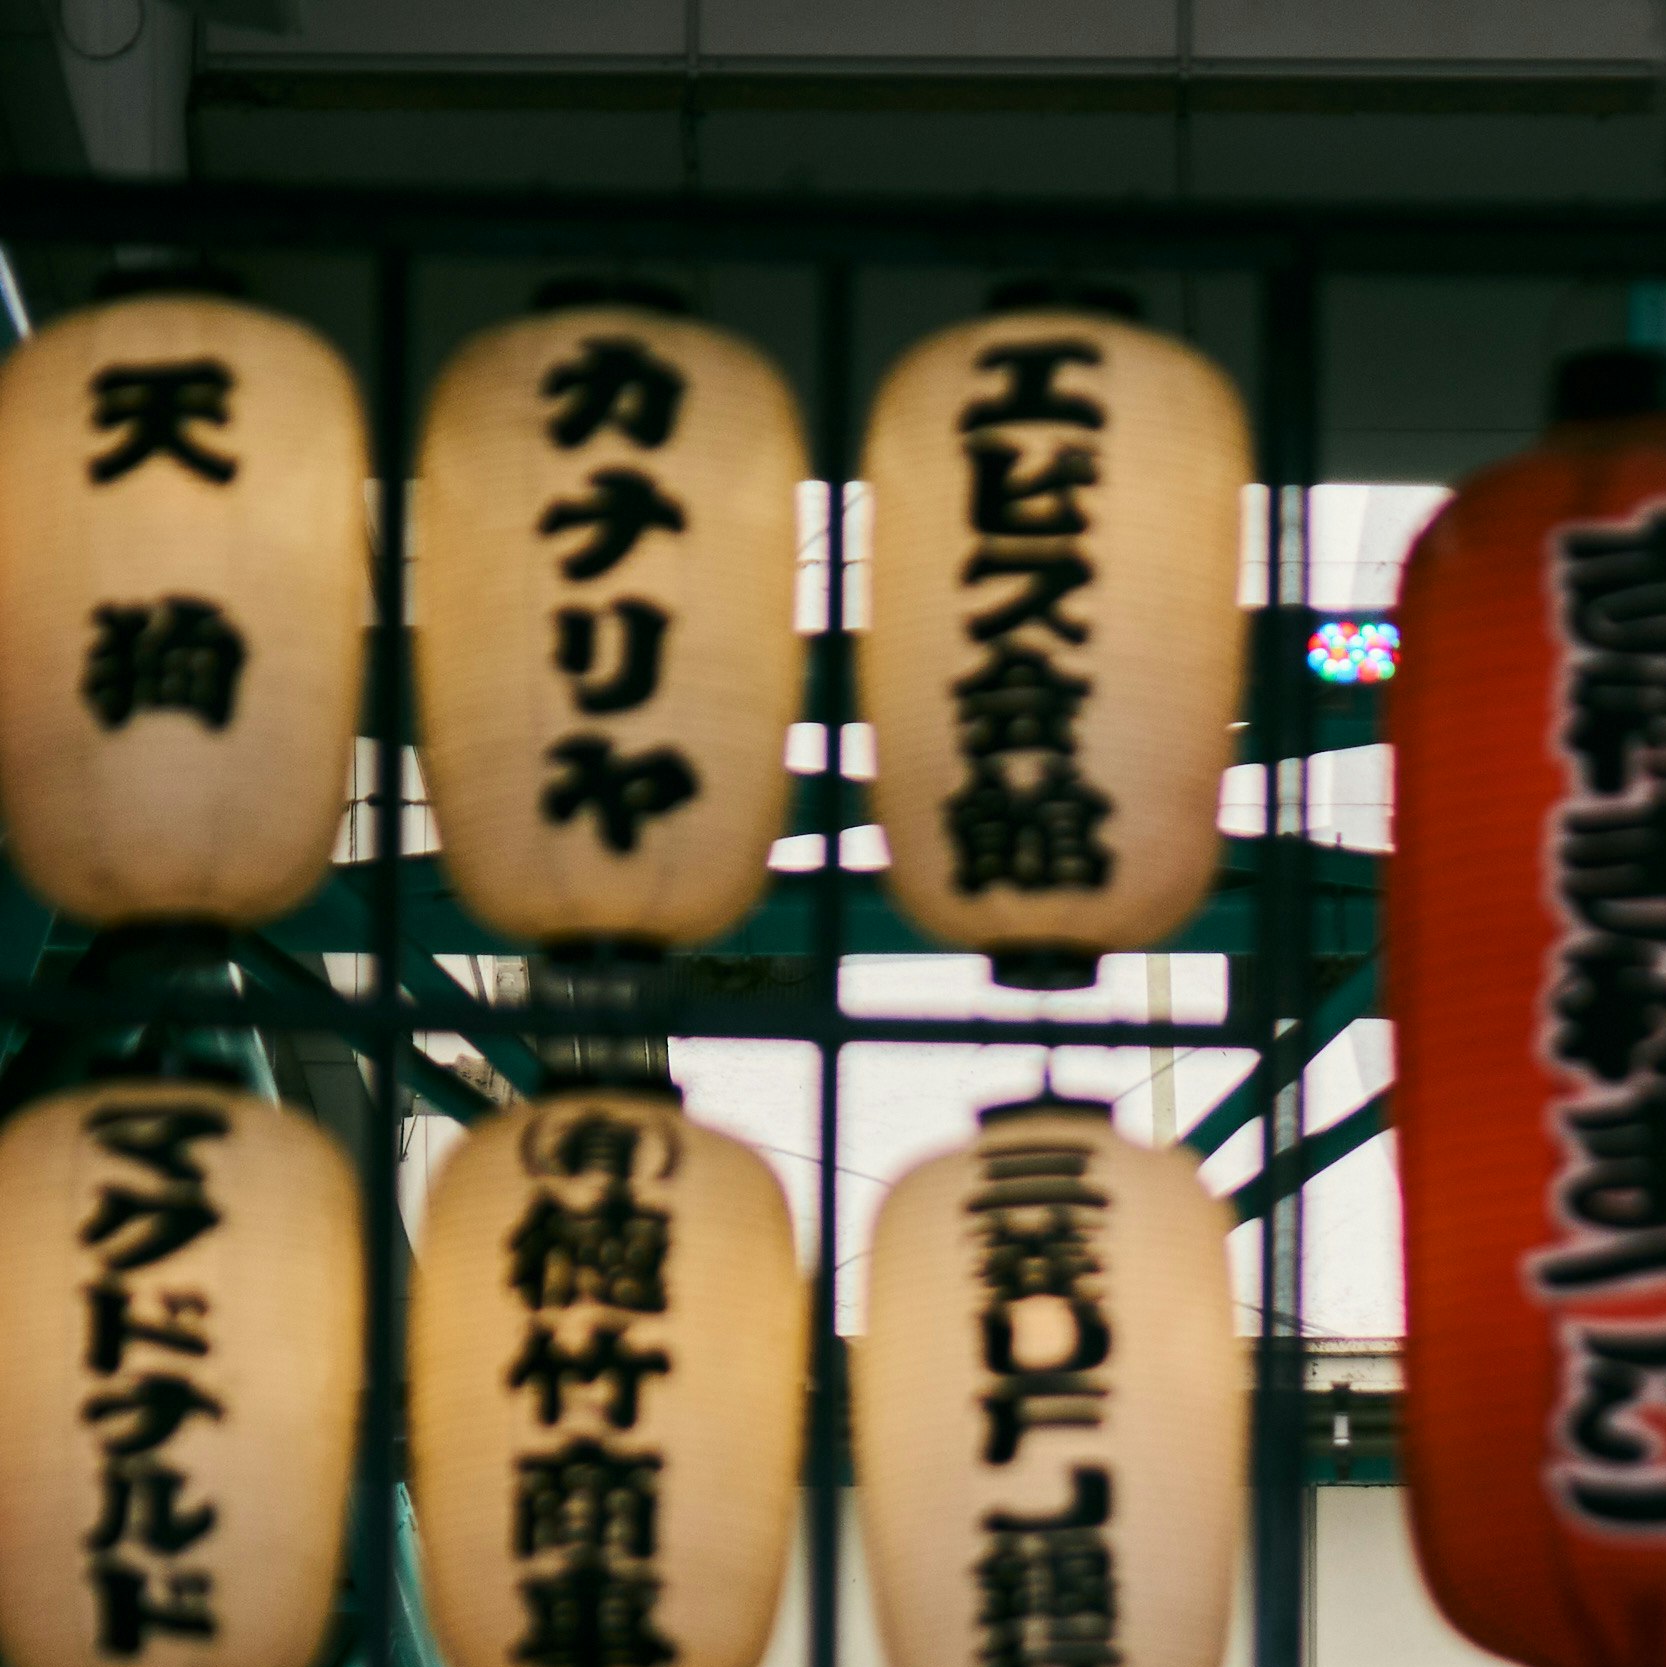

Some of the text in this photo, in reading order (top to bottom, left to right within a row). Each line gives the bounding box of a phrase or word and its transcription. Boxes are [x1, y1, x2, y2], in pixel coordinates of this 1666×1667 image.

[538, 334, 702, 858] カナリヤ
[78, 1103, 227, 1662] マクドナルド
